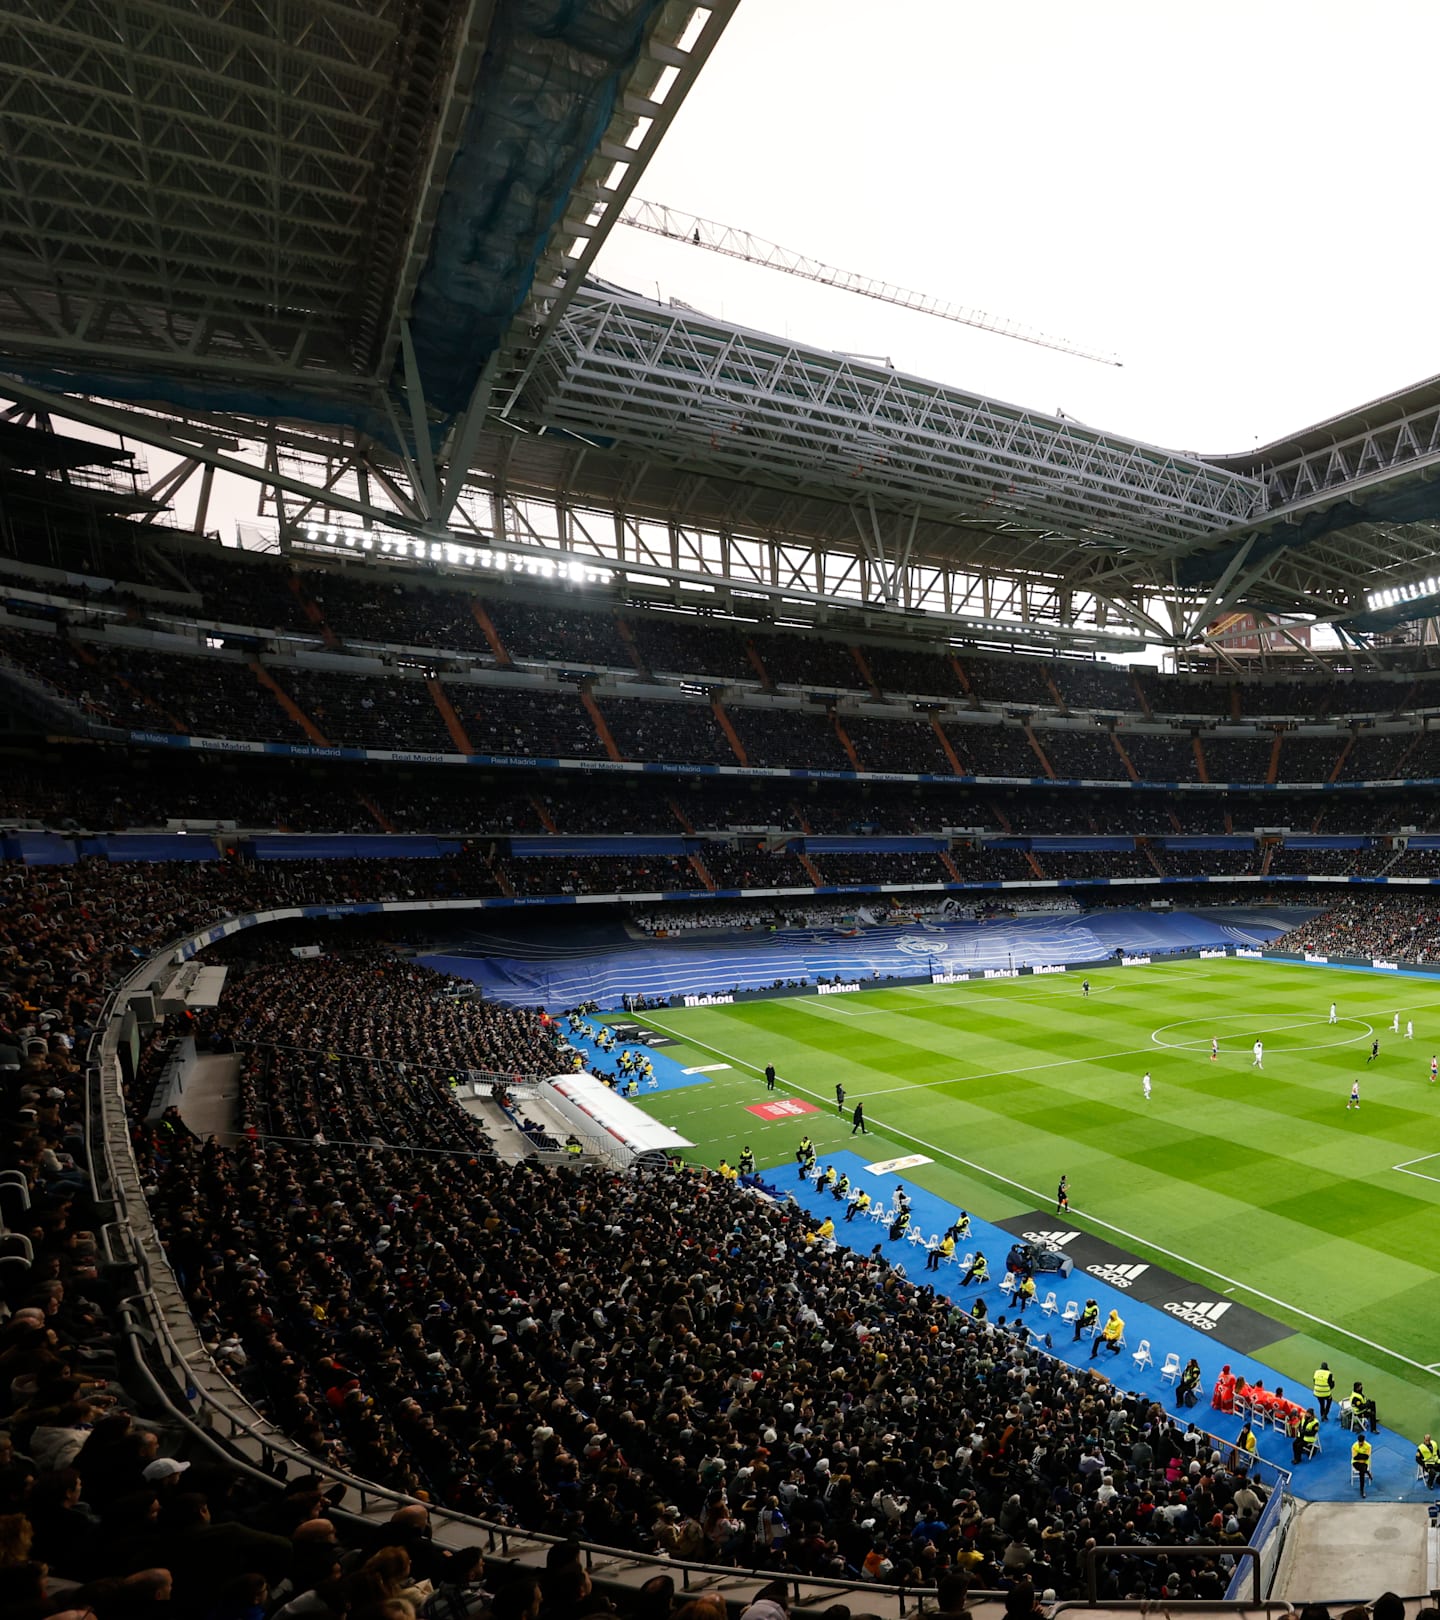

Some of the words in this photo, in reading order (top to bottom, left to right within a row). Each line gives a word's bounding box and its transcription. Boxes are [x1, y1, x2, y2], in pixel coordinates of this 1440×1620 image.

[202, 740, 220, 749] Real
[221, 742, 251, 751] Madrid
[290, 746, 310, 754] Real
[311, 747, 341, 757] Madrid
[413, 754, 443, 762] Madrid
[491, 757, 508, 765] Real
[510, 758, 536, 766] Madrid
[1200, 950, 1227, 958] Mahou
[1236, 949, 1262, 957] Mahou
[1122, 957, 1151, 966] Mahou
[1305, 954, 1328, 963] Mahou
[1032, 964, 1066, 974] Mahou
[1372, 960, 1398, 970] Mahou
[817, 983, 860, 995] Mahou
[684, 995, 734, 1007] Mahou
[1086, 1264, 1133, 1289] adidas
[1163, 1302, 1217, 1330] adidas
